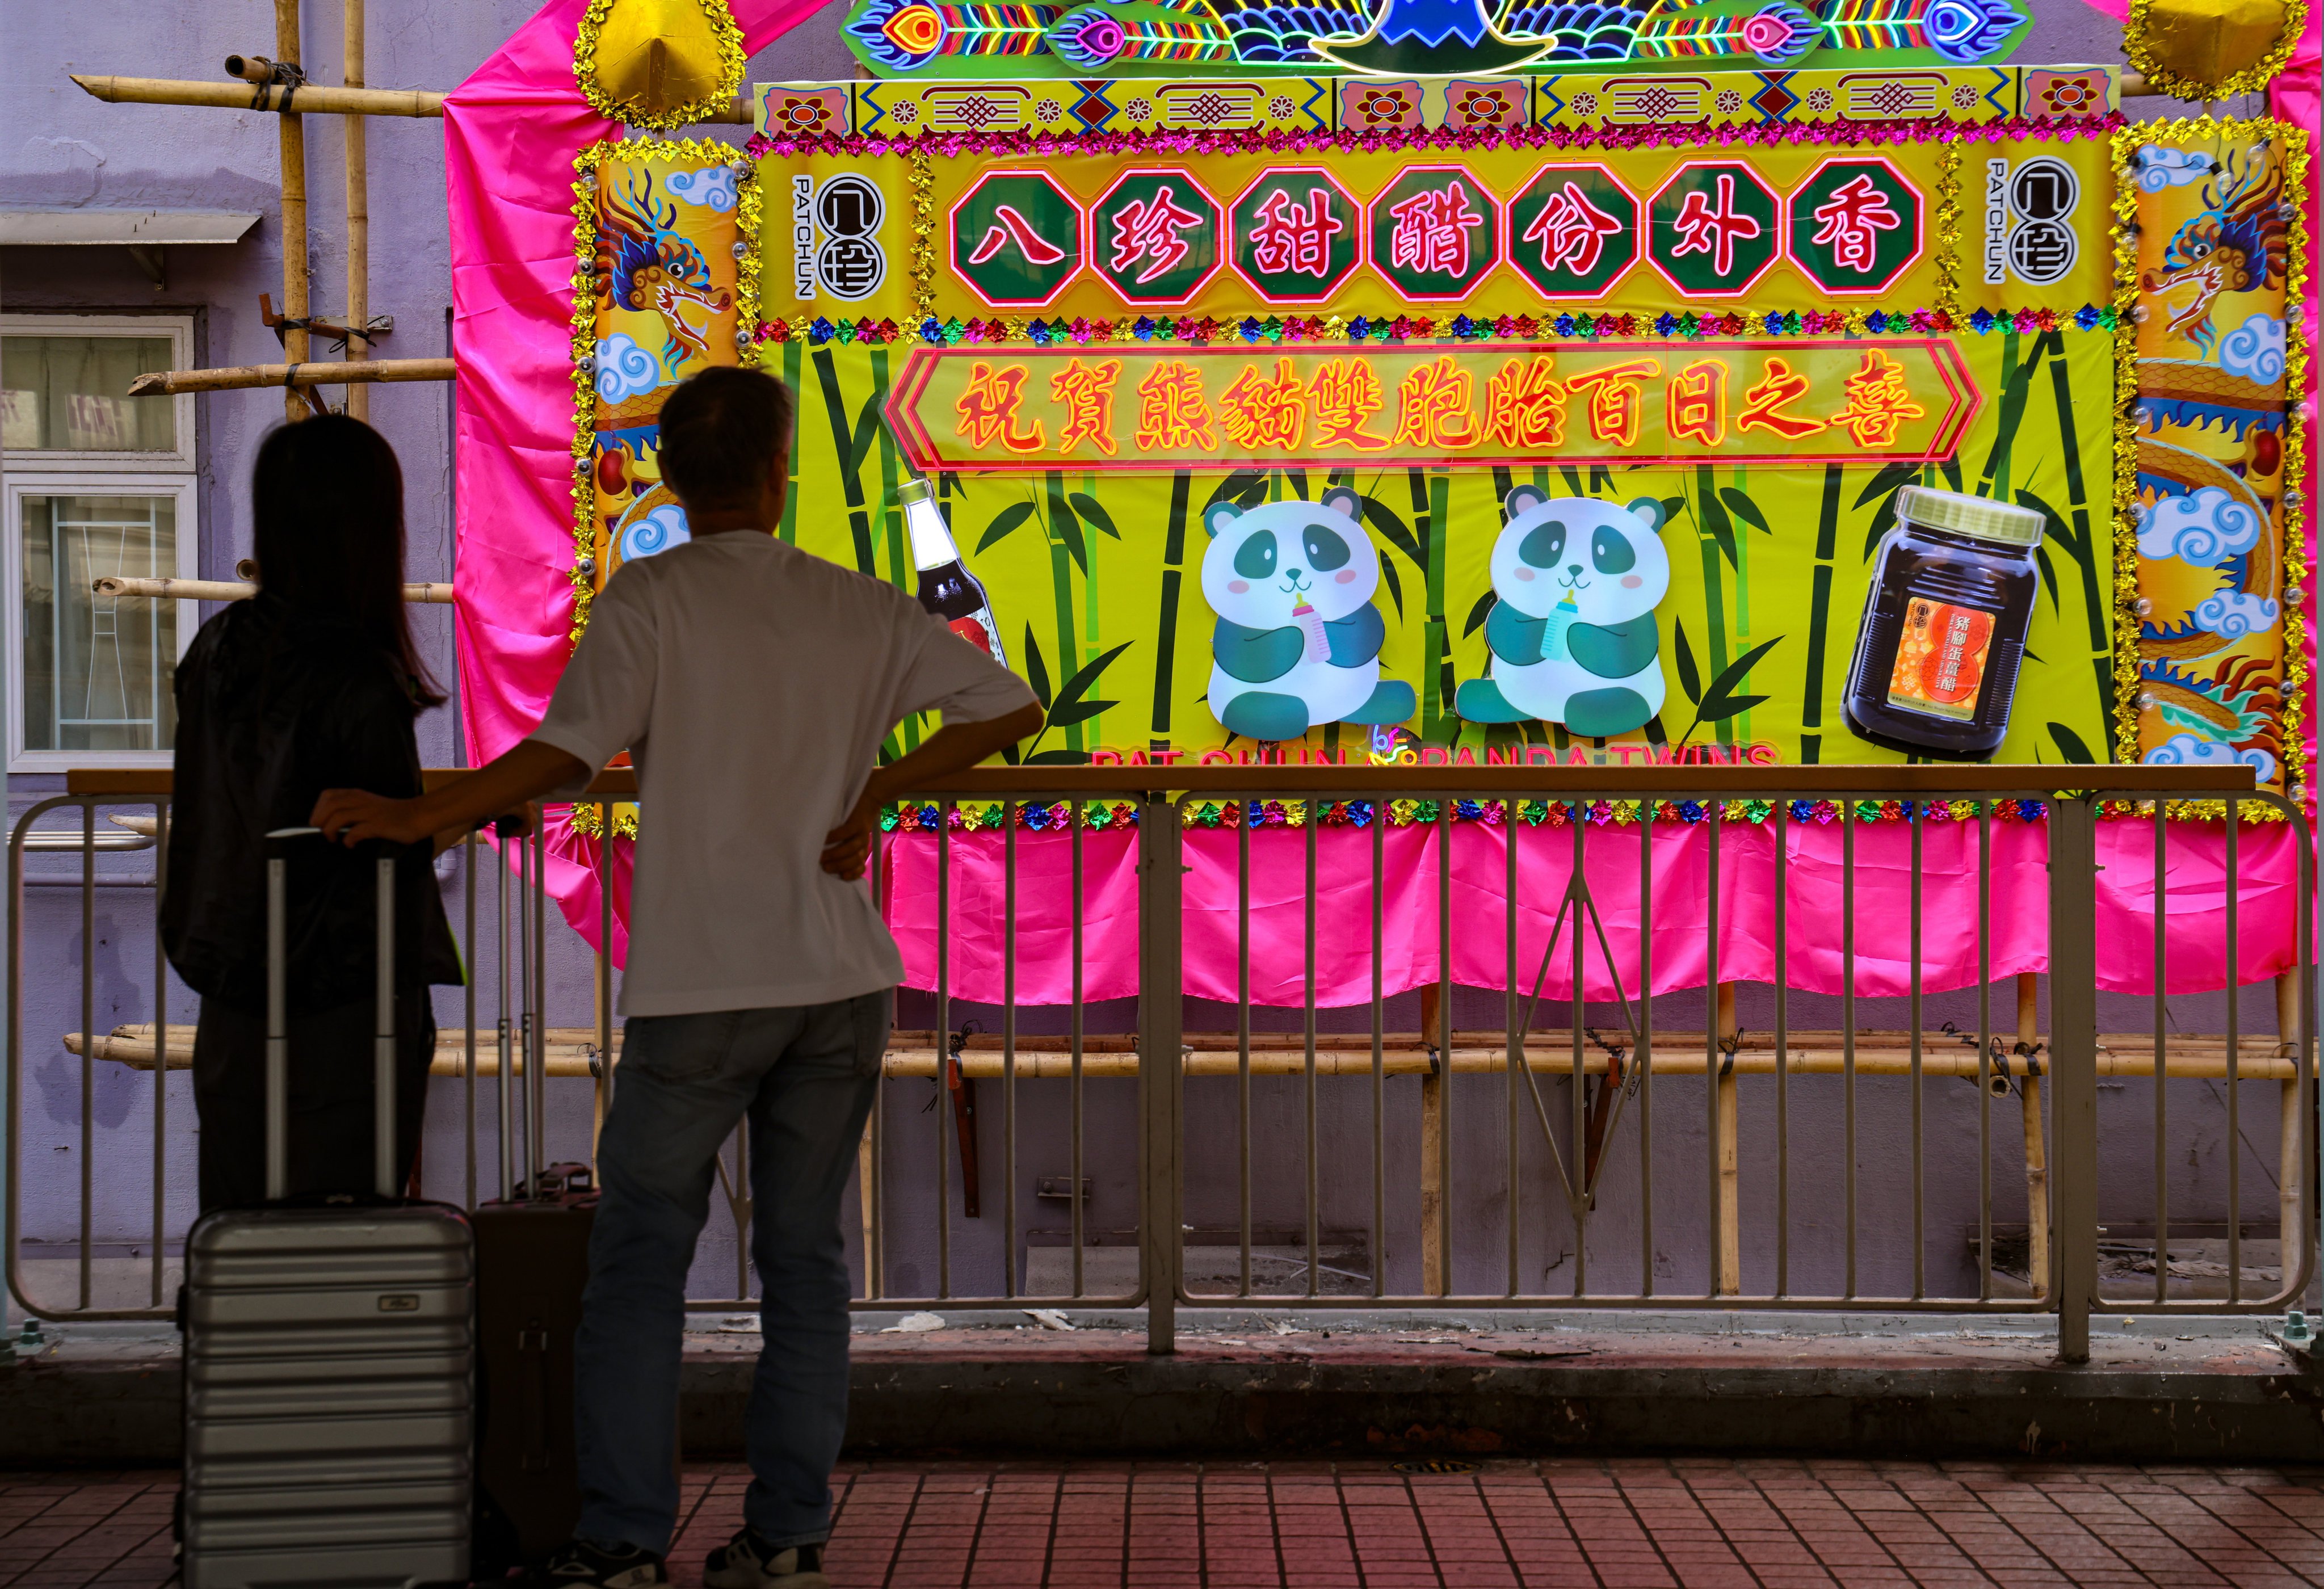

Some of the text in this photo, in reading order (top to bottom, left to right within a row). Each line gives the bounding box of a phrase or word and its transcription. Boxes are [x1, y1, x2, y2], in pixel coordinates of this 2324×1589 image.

[796, 179, 812, 296] PATCHUN
[968, 174, 1901, 284] 八珍甜醋份外香
[1989, 162, 2004, 280] PATCHUN
[956, 348, 1924, 456] 祝賀熊貓雙胞胎百日之喜
[1908, 602, 1917, 627] PATCHUN
[1944, 626, 1953, 649] KNUCKLES
